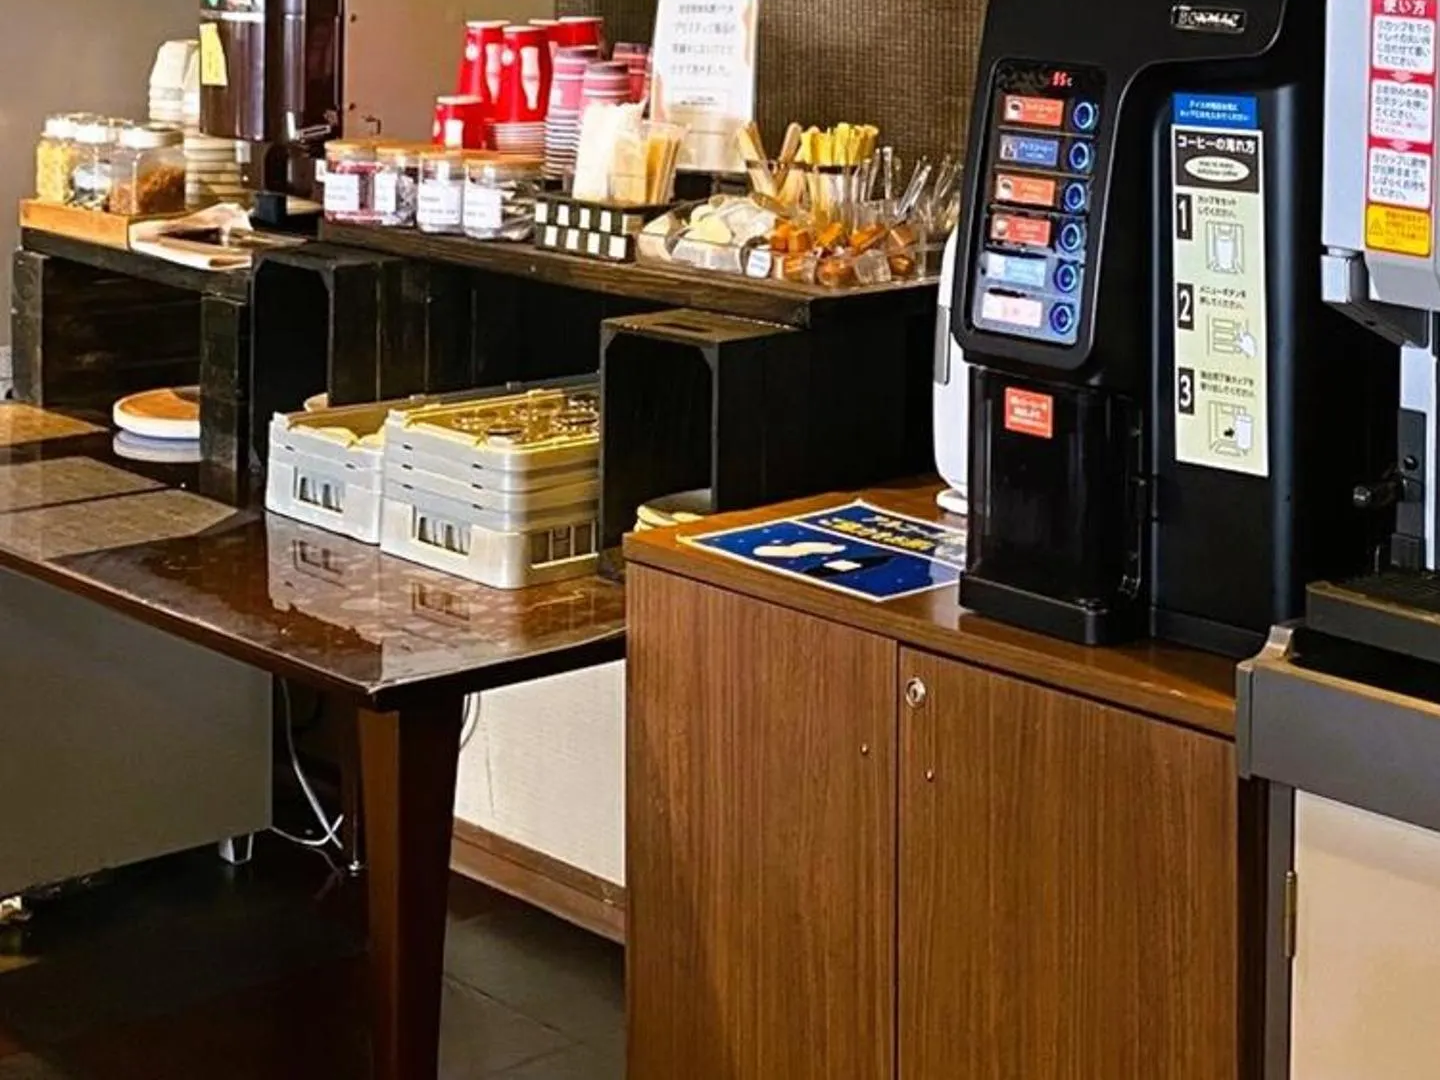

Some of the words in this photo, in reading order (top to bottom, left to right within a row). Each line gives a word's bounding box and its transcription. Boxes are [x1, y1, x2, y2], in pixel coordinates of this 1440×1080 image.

[1179, 199, 1187, 231] 1
[1180, 289, 1191, 322] 2
[1180, 375, 1191, 407] 3
